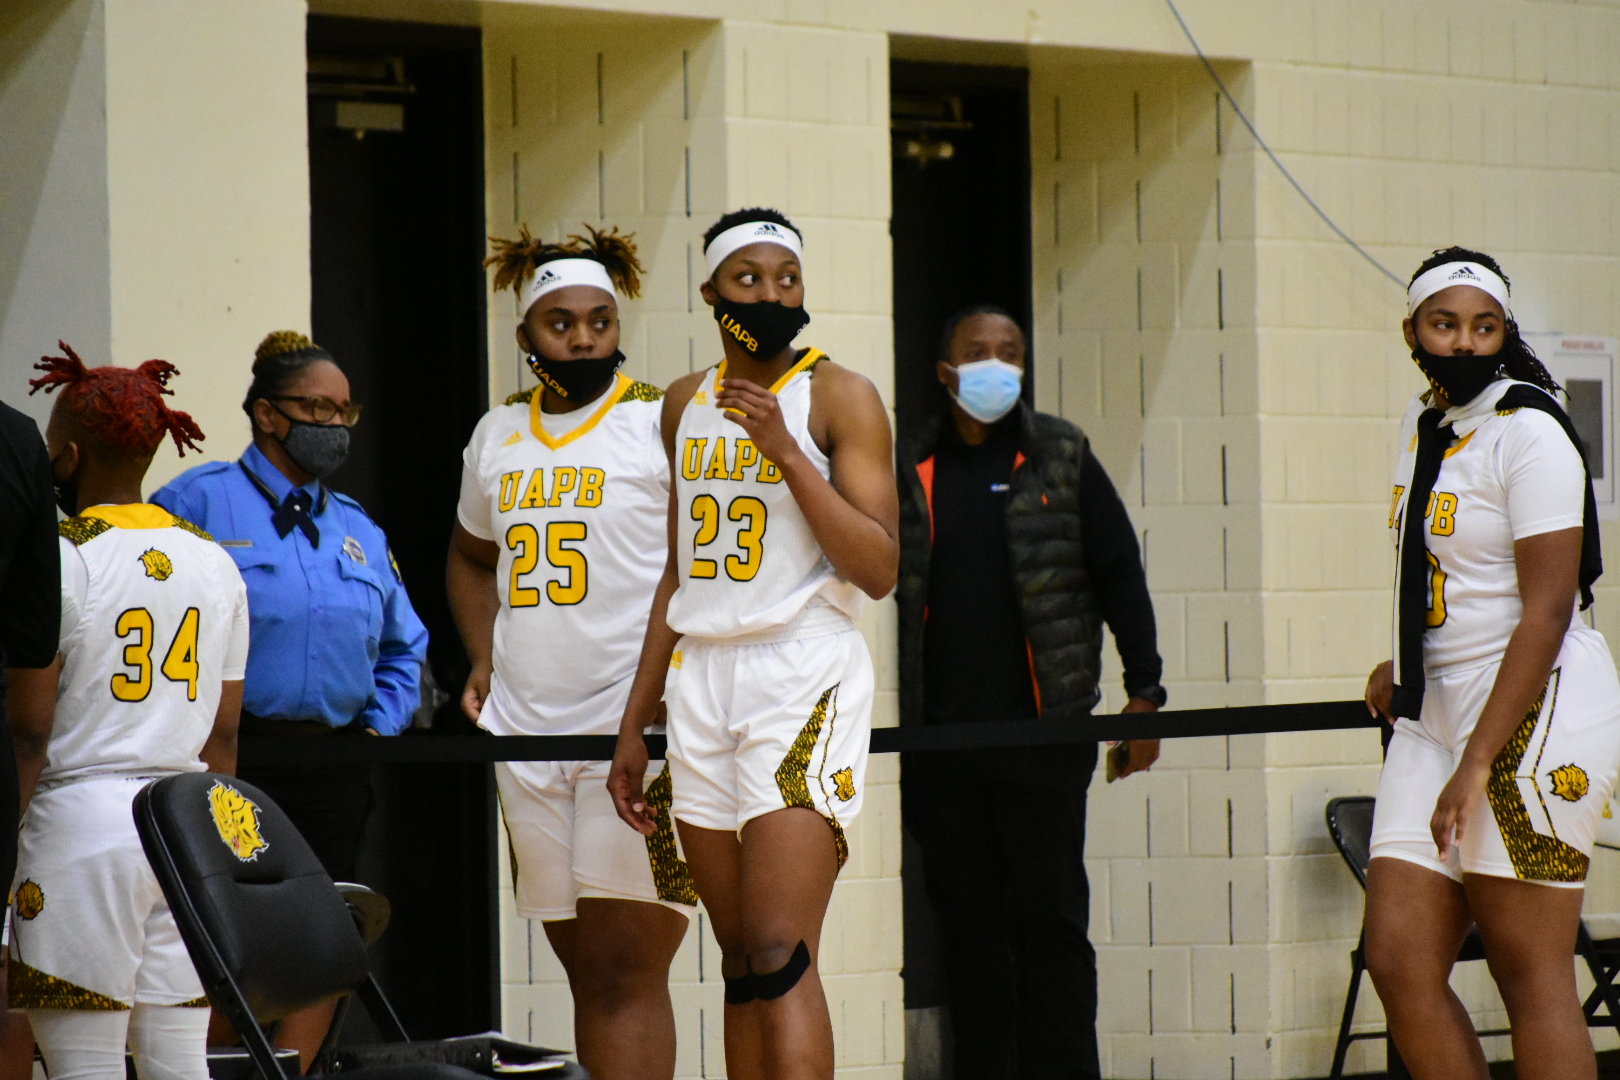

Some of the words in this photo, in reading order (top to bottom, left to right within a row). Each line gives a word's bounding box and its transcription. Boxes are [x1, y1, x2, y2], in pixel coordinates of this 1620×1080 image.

[754, 229, 784, 239] adidas
[1448, 273, 1481, 281] adidas
[721, 313, 758, 352] UAPB
[532, 361, 568, 397] UAPB
[498, 465, 605, 513] UAPB
[689, 494, 767, 582] 23
[505, 521, 588, 608] 25
[110, 607, 199, 703] 34
